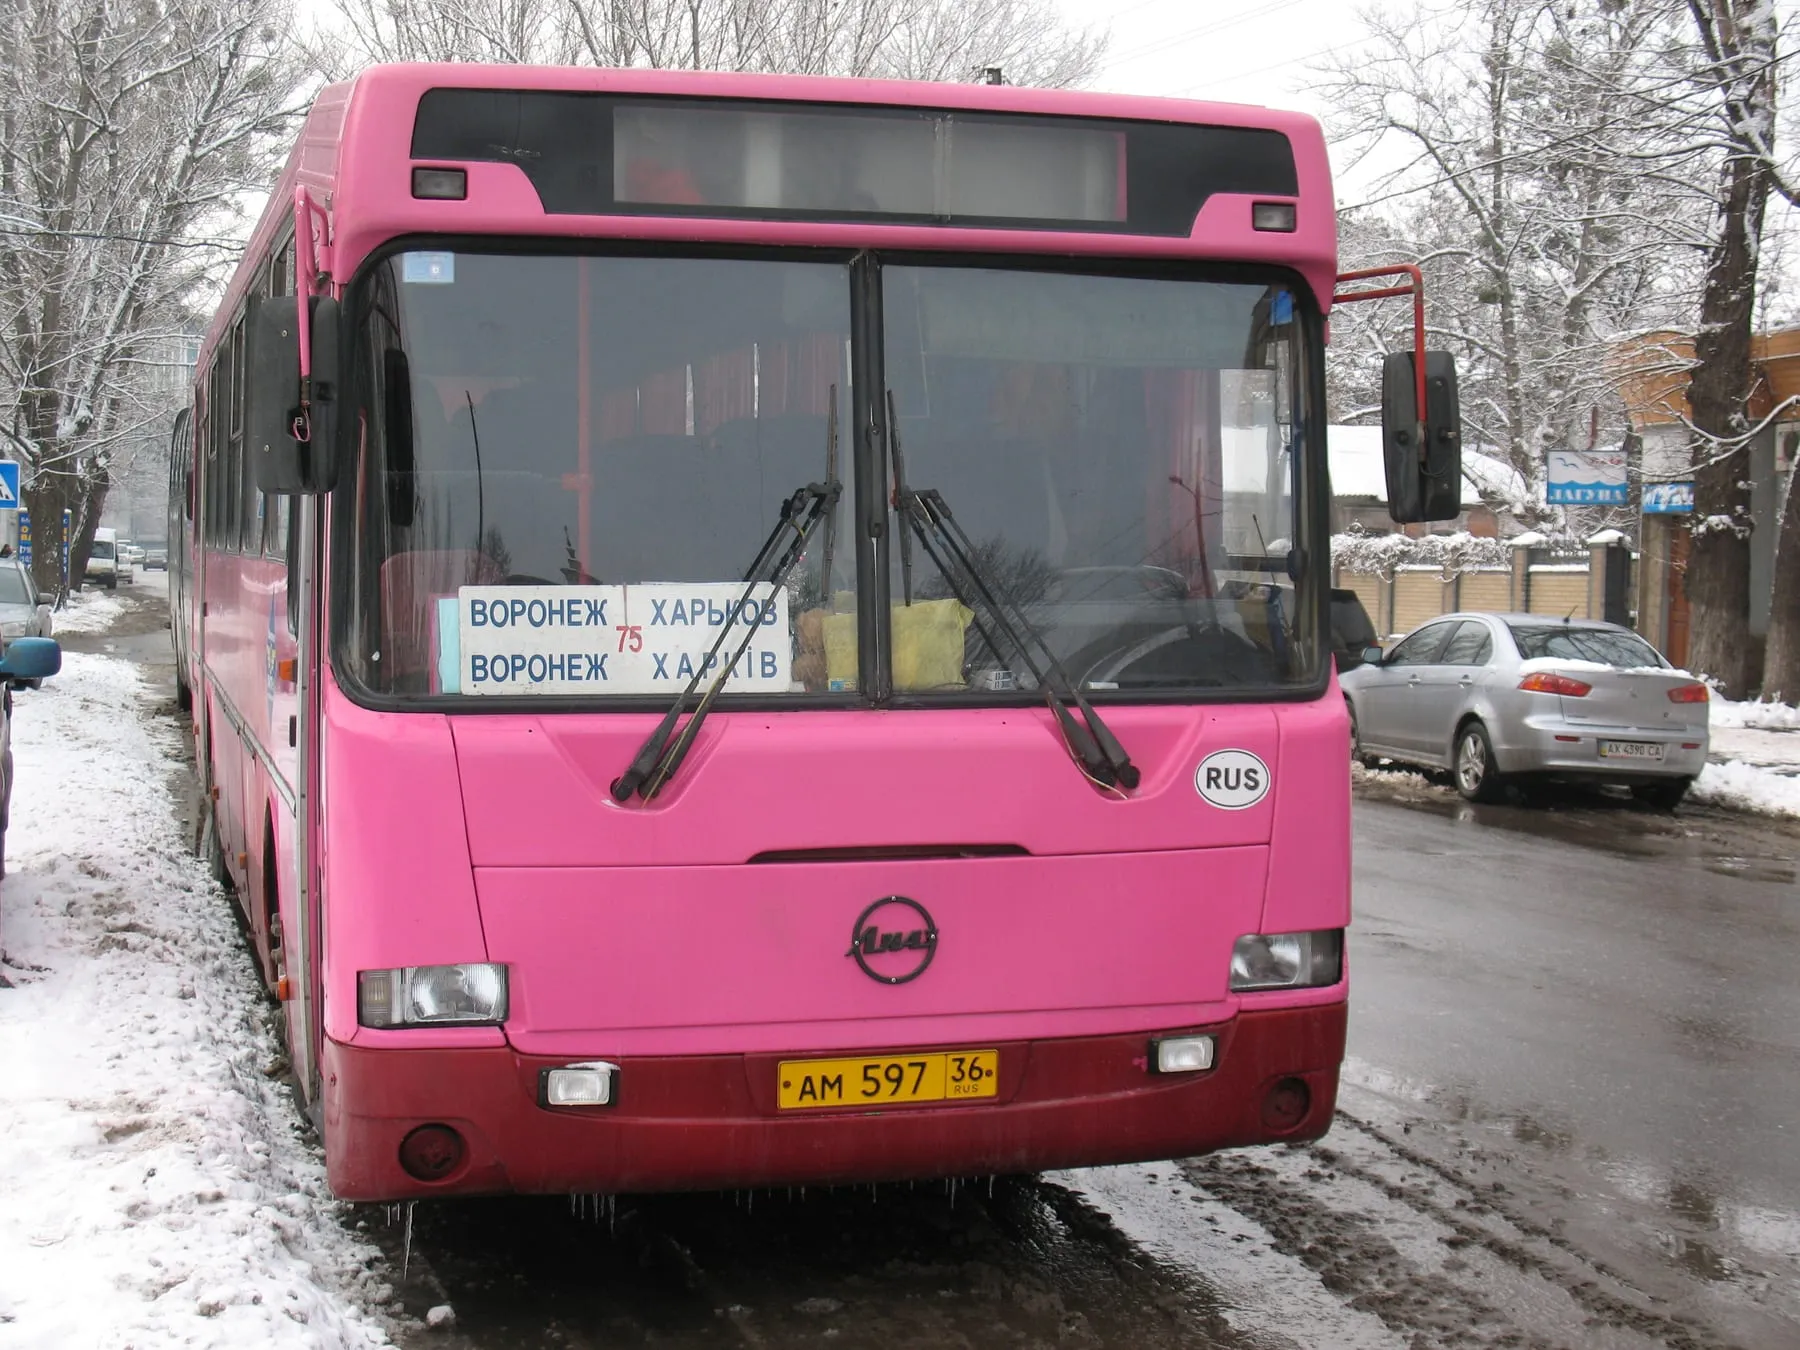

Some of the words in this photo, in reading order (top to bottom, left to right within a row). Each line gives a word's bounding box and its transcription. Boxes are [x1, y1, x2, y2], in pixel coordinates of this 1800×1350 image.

[471, 599, 608, 627] ВОРОНЕЖ
[650, 598, 778, 626] ХАРЬКОВ
[616, 625, 643, 653] 75
[471, 653, 608, 682] ВОРОНЕЖ
[1206, 767, 1260, 791] RUS
[861, 1062, 927, 1097] 597
[951, 1056, 984, 1082] 36
[954, 1083, 979, 1094] RUS
